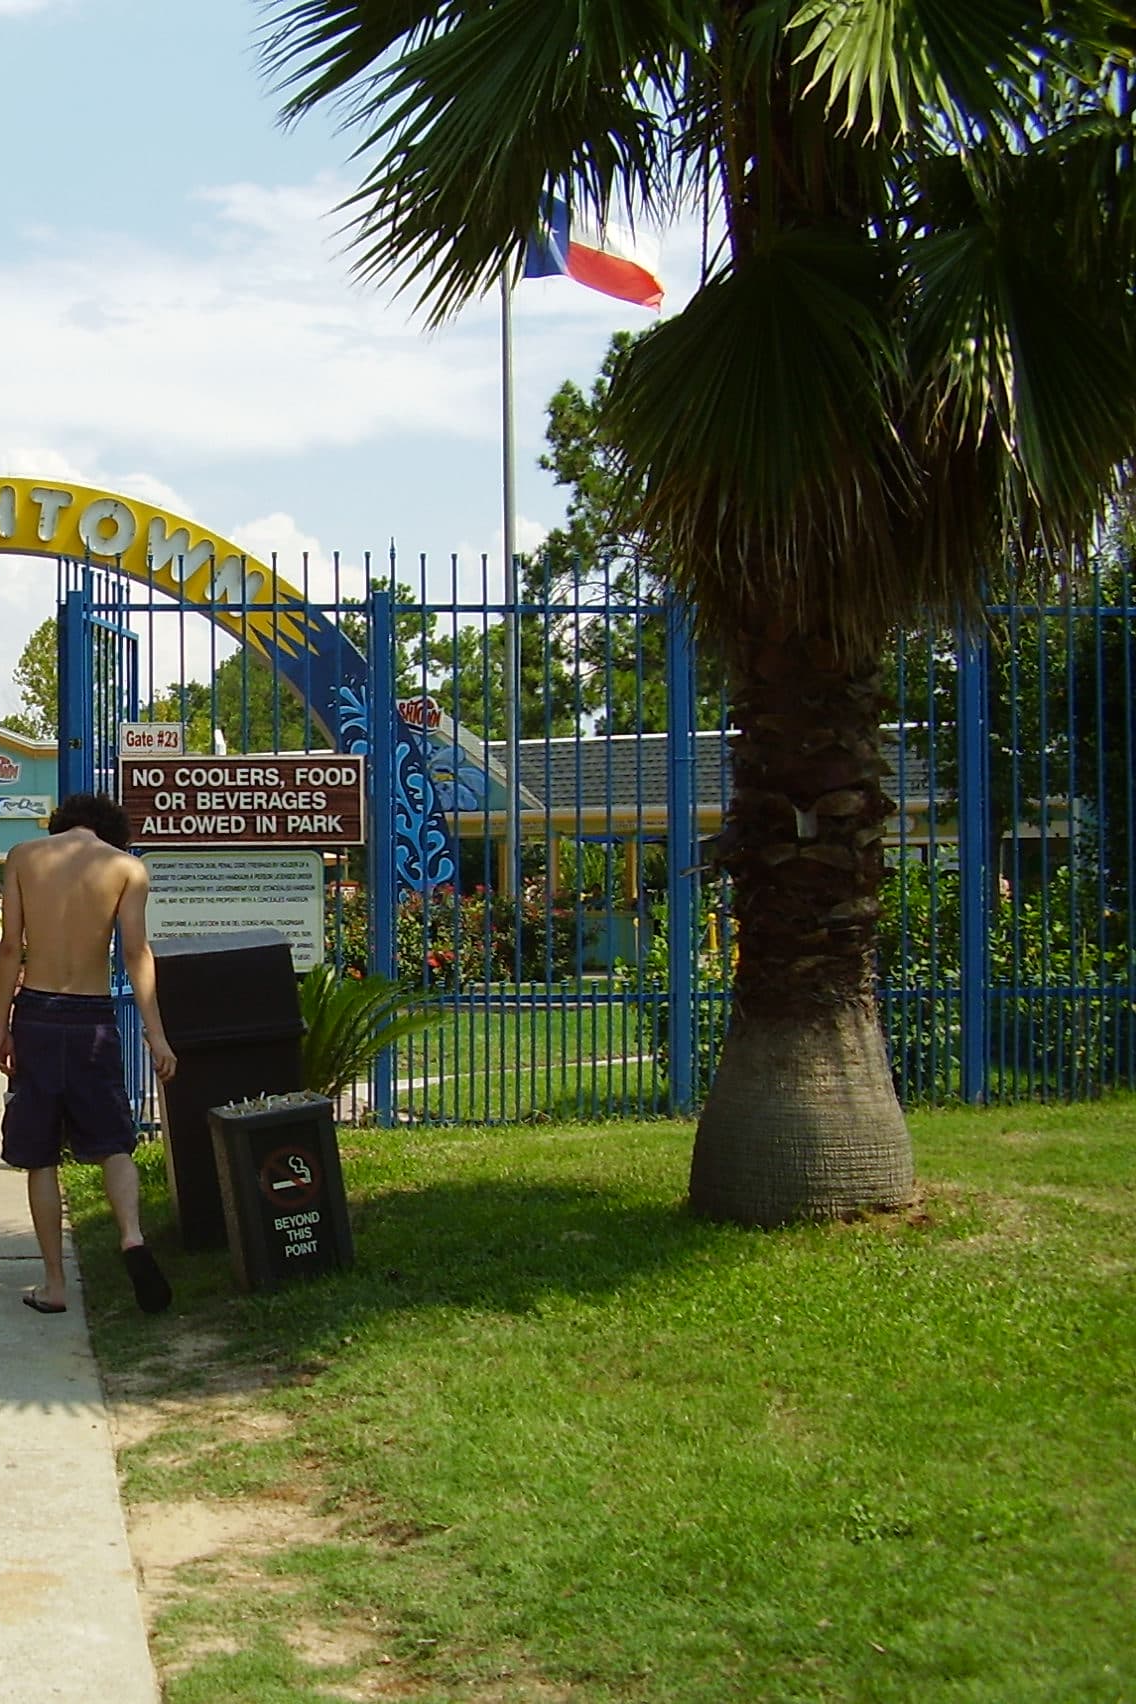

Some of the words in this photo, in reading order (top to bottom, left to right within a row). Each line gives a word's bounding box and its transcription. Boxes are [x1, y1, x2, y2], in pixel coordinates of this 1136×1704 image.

[126, 730, 153, 747] Gate
[157, 730, 179, 748] #23
[132, 768, 164, 787] NO
[174, 768, 286, 789] COOLERS,
[295, 767, 357, 786] FOOD
[154, 792, 186, 810] OR
[197, 791, 327, 810] BEVERAGES
[141, 815, 246, 834] ALLOWED
[256, 815, 277, 833] IN
[287, 815, 343, 833] PARK
[274, 1211, 320, 1231] BEYOND
[286, 1227, 313, 1242] THIS
[285, 1240, 318, 1258] POINT
